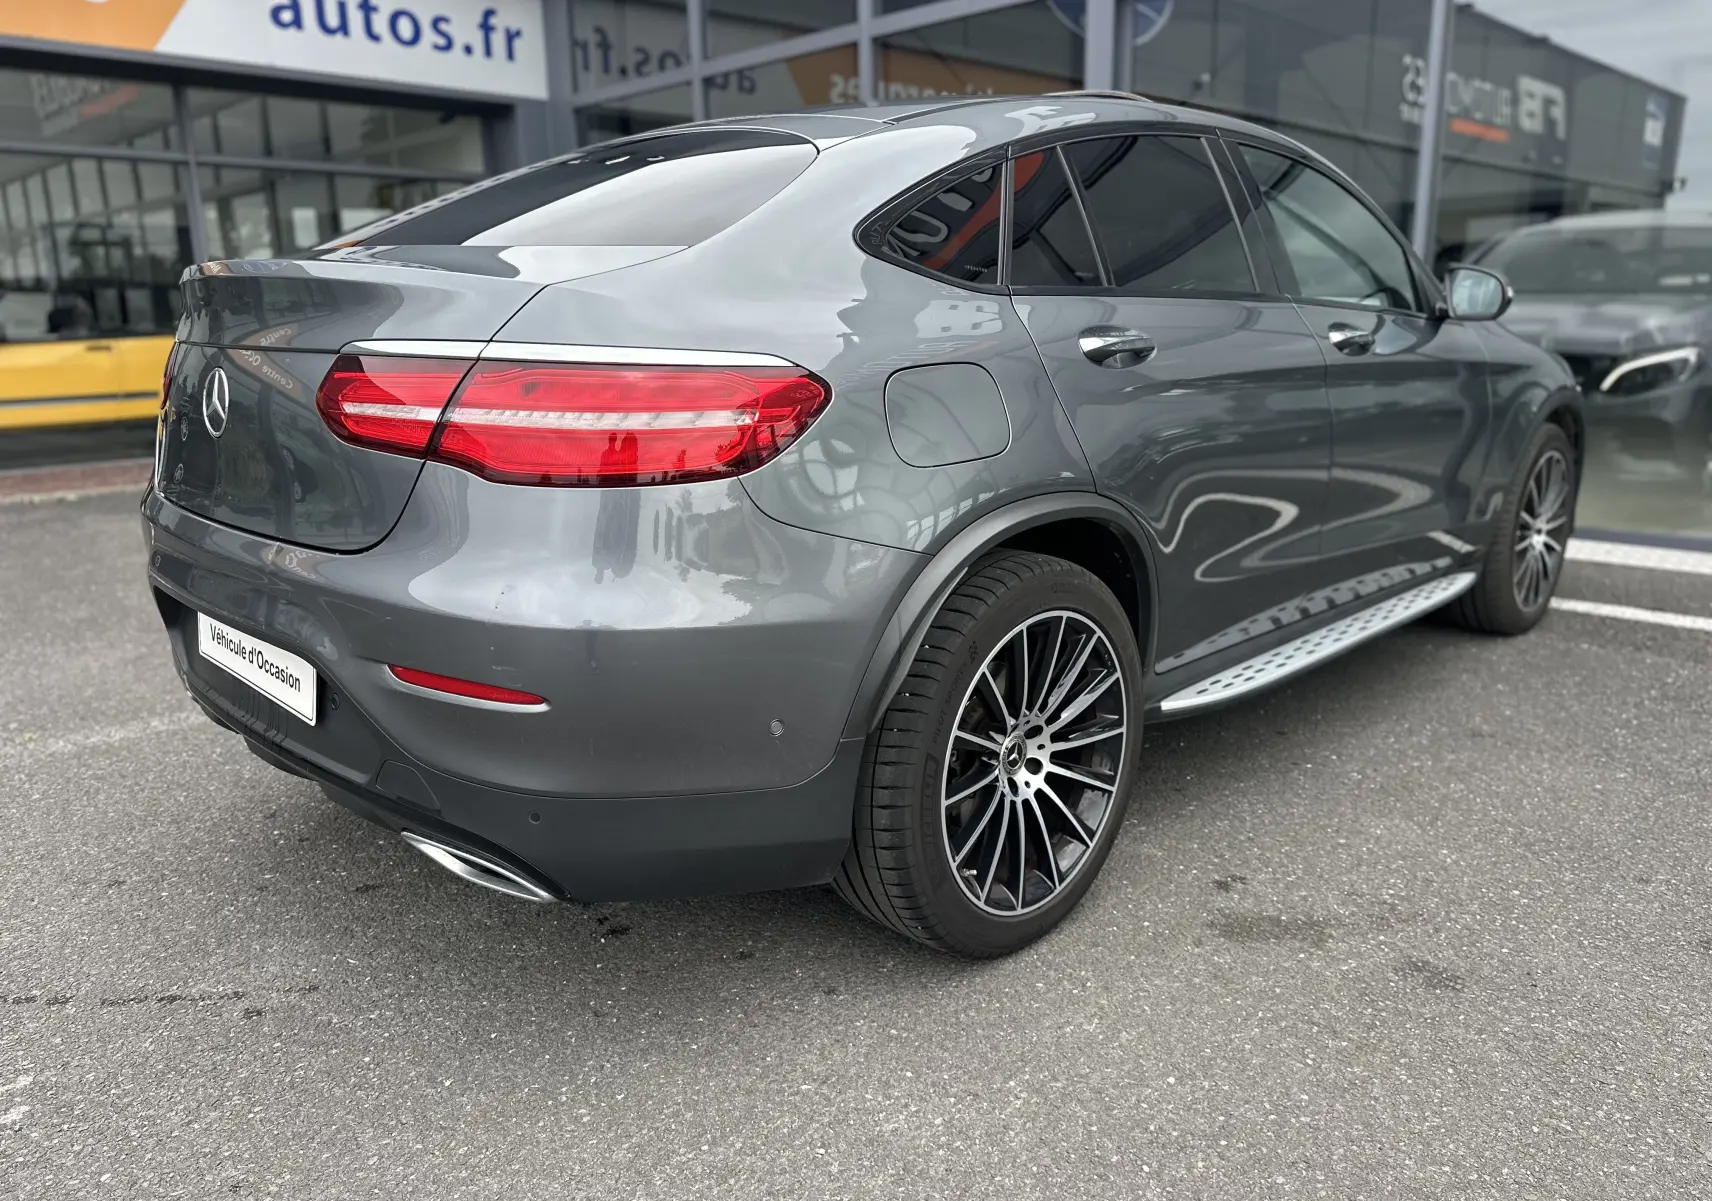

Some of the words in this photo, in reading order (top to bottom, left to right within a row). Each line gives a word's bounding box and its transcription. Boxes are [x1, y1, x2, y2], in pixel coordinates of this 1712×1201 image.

[269, 0, 523, 62] autos.fr
[209, 622, 247, 660] Véhicule
[248, 646, 301, 693] d'Occasion
